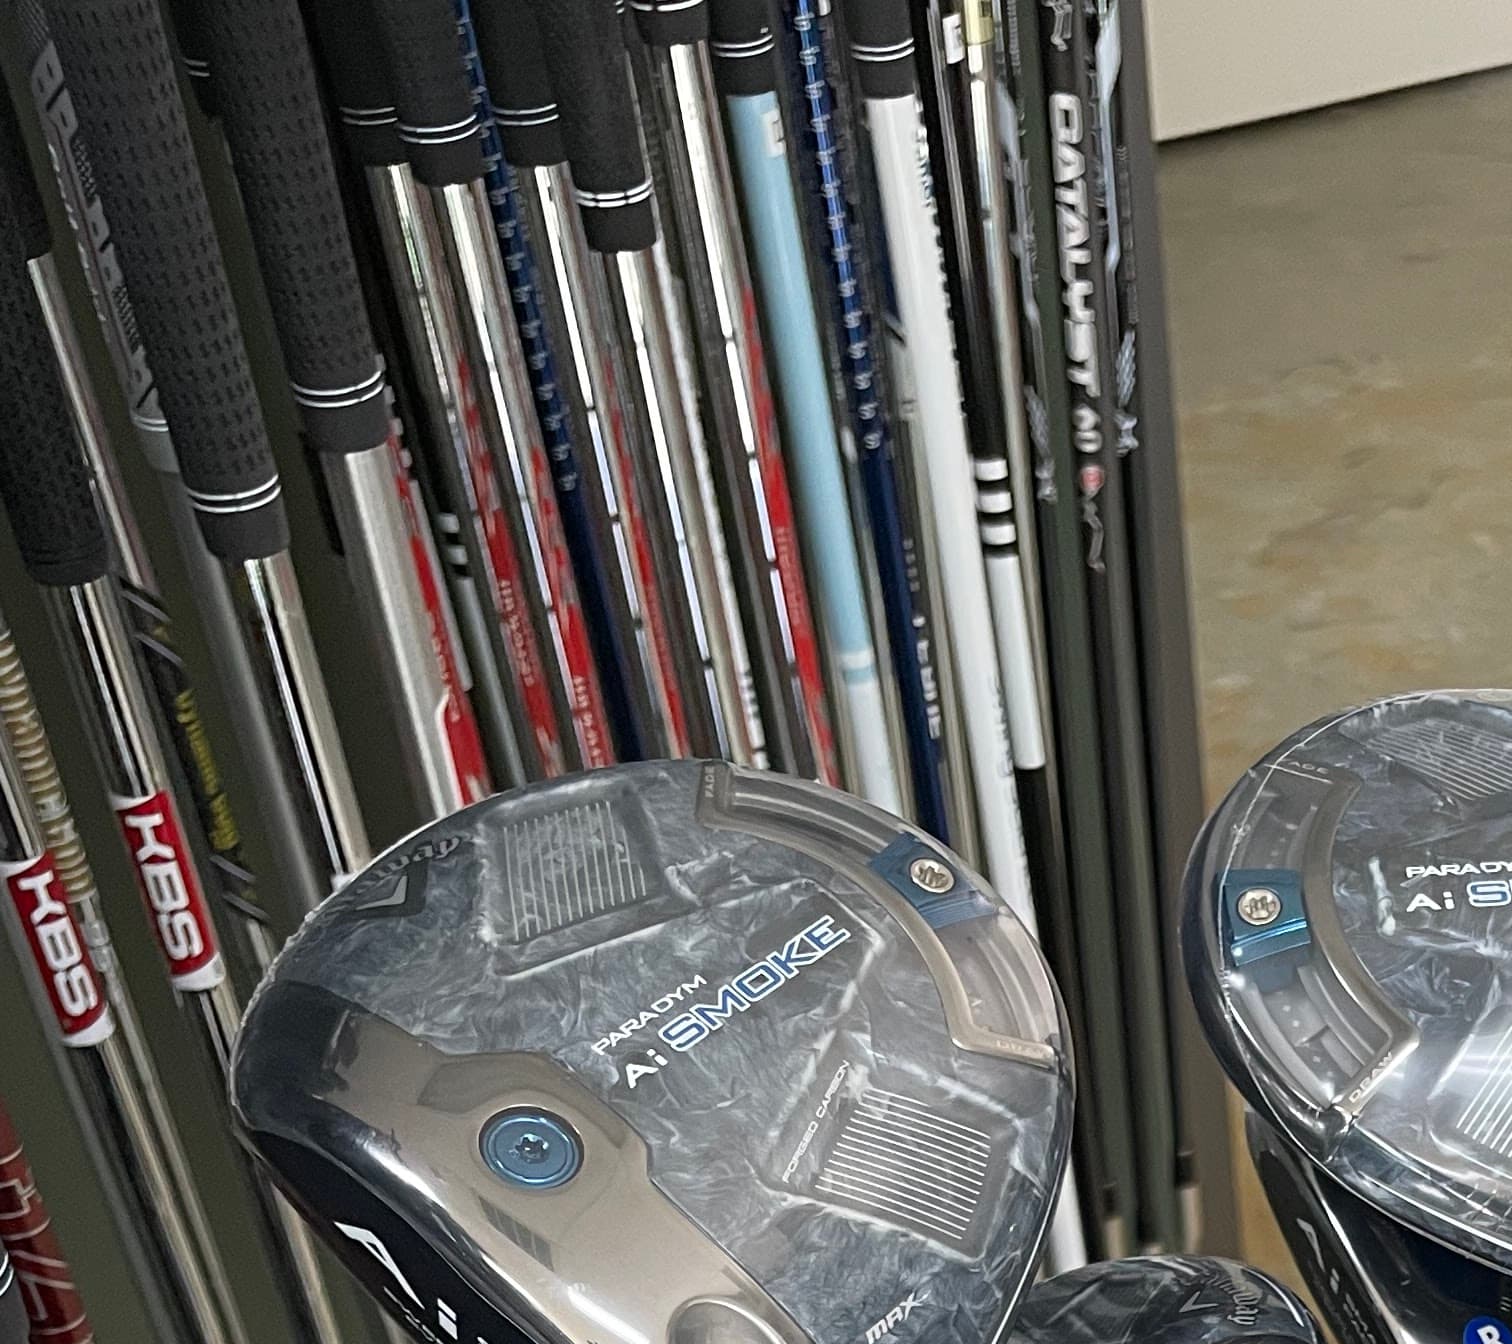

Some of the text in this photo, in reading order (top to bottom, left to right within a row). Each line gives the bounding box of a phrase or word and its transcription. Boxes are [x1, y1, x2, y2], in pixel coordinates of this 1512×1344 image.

[17, 869, 98, 1018] KBS
[124, 811, 205, 962] KBS
[1405, 891, 1456, 912] Ai
[591, 974, 708, 1056] PARADYM
[625, 914, 852, 1089] Ai SMOKE
[782, 1060, 850, 1184] FORGED CARBON
[1349, 1051, 1394, 1103] DRAW
[334, 1221, 457, 1340] Ai
